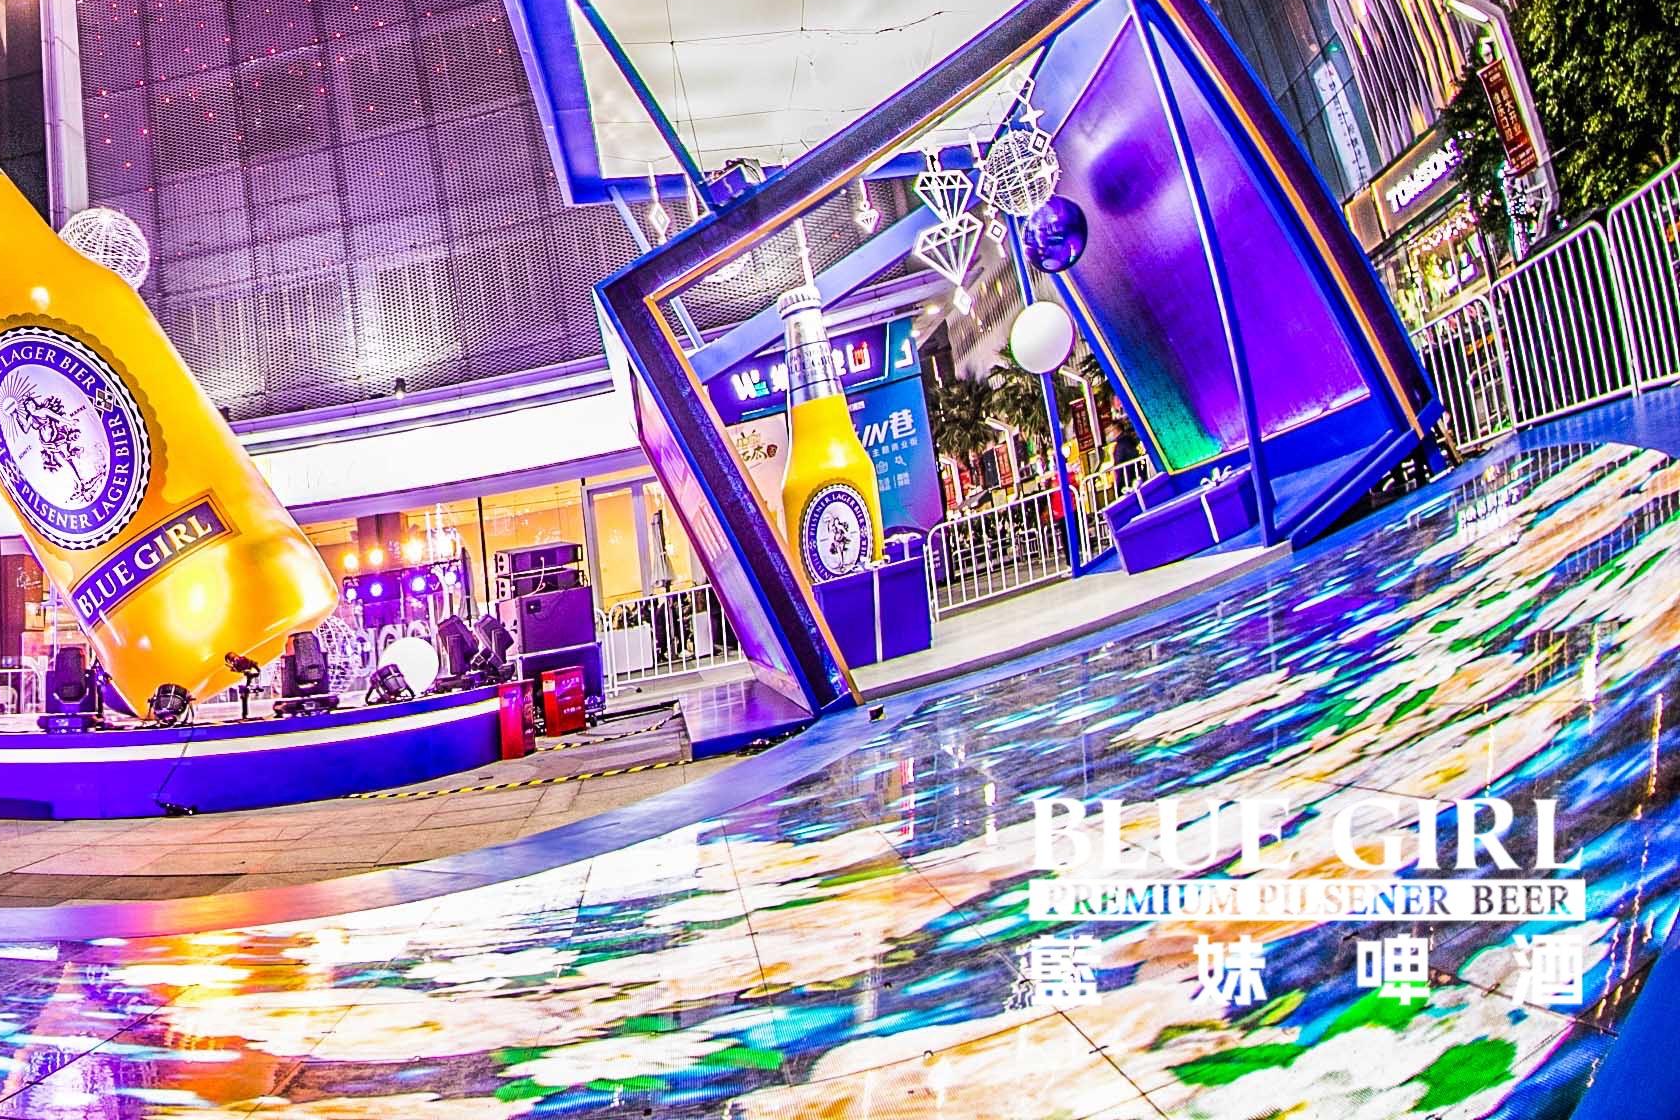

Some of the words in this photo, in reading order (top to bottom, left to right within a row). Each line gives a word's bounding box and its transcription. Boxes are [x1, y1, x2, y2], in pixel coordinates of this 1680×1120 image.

[0, 346, 56, 367] LAGER
[58, 355, 96, 391] BIER
[108, 413, 130, 458] BIER
[21, 483, 91, 530] PILSENER
[92, 462, 130, 522] LAGER
[831, 493, 855, 508] LAGER
[77, 560, 136, 617] BLUE
[133, 513, 213, 570] GIRL
